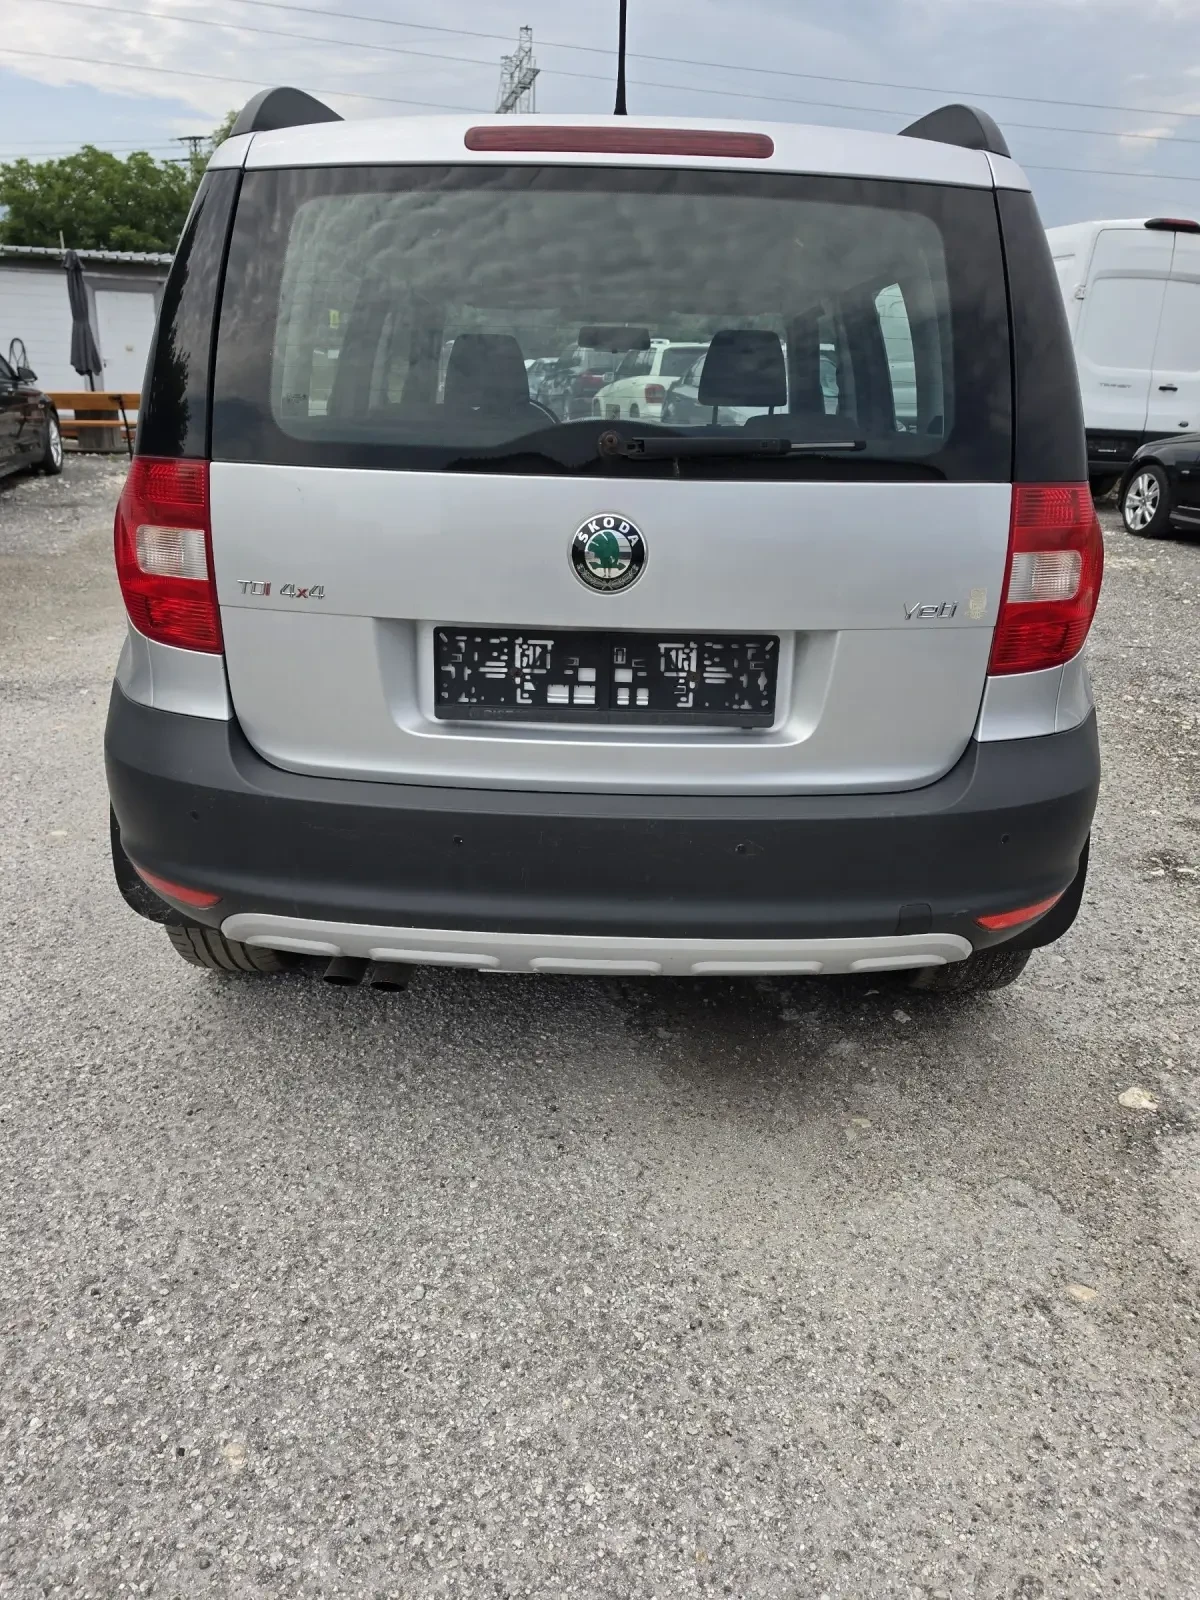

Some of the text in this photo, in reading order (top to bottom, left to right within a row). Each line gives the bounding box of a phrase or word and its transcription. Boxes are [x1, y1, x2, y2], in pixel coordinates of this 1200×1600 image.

[237, 579, 325, 599] TDI 4x4
[903, 600, 958, 621] Yeti
